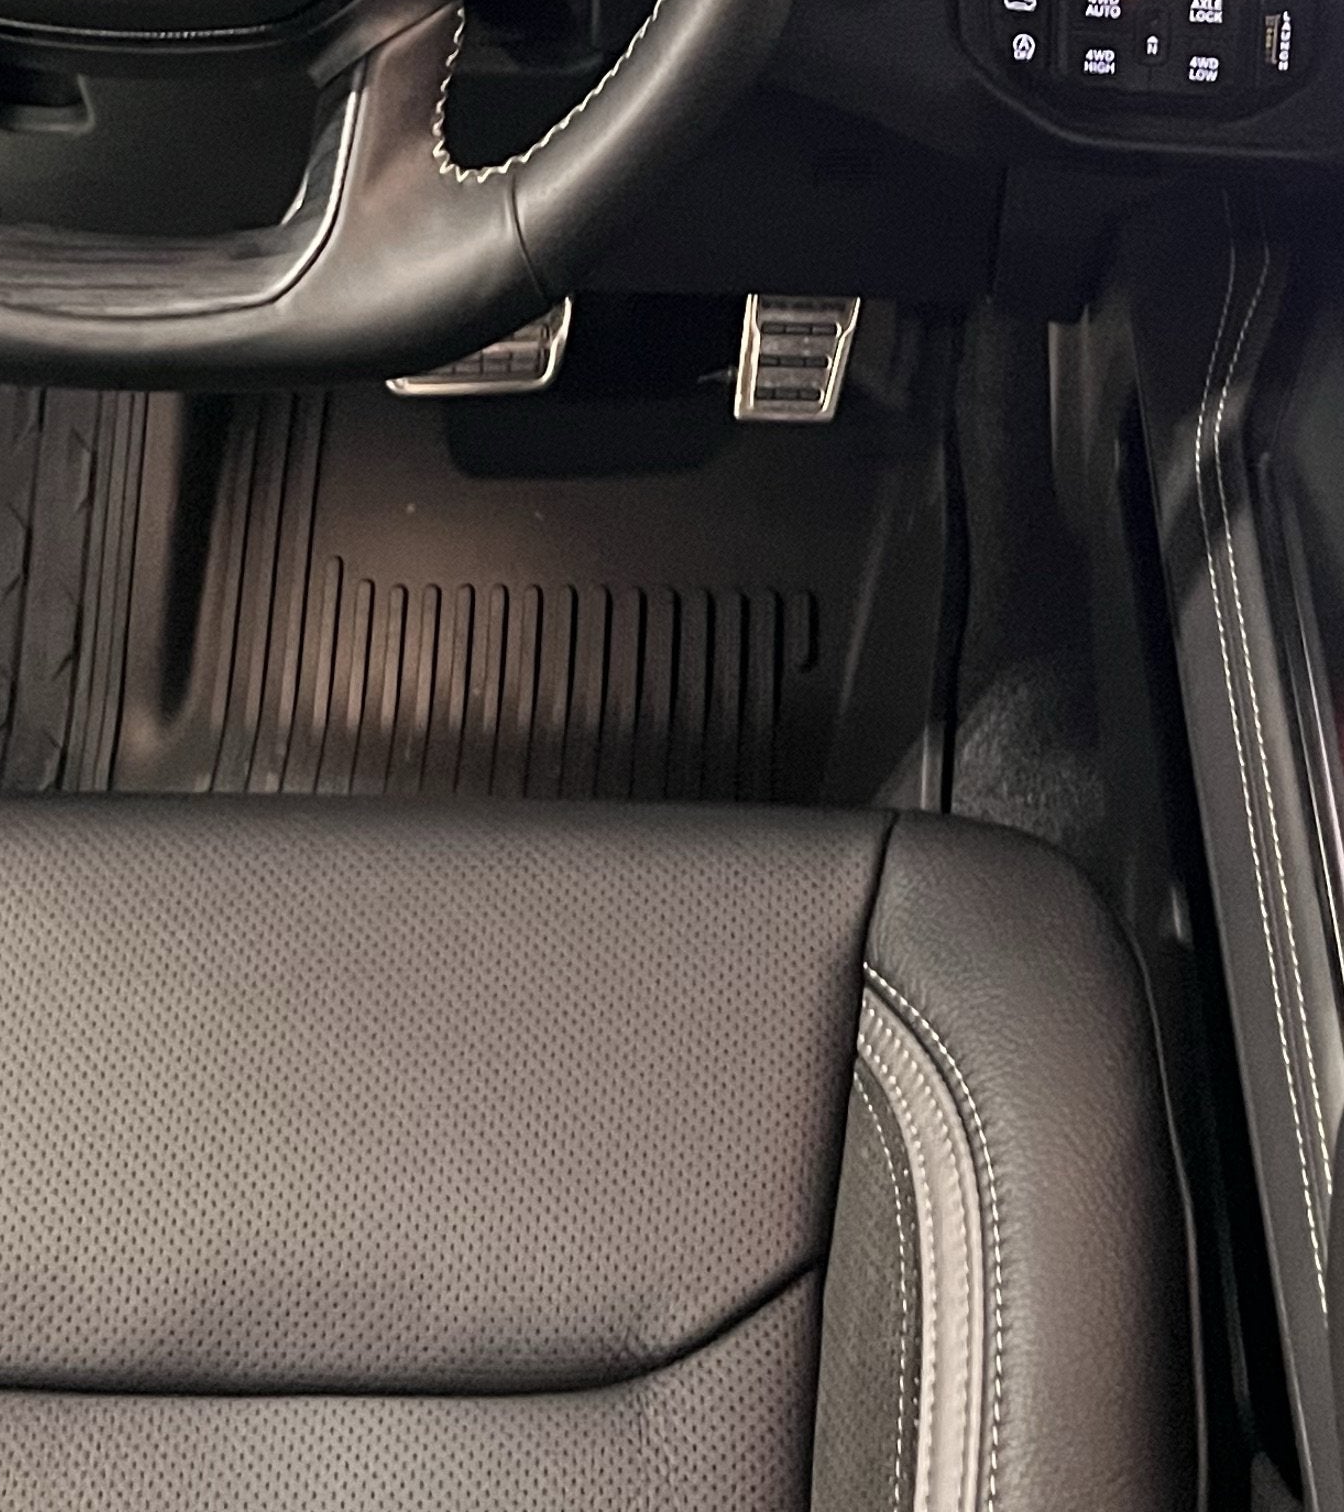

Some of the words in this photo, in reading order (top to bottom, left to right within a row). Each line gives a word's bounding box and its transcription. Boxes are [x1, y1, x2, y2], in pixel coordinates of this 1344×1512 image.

[1085, 4, 1122, 19] AUTO
[1189, 10, 1223, 23] LOCK
[1085, 49, 1115, 62] 4WD
[1083, 61, 1116, 75] HIGH
[1189, 56, 1219, 69] 4WD
[1188, 68, 1218, 82] LOW
